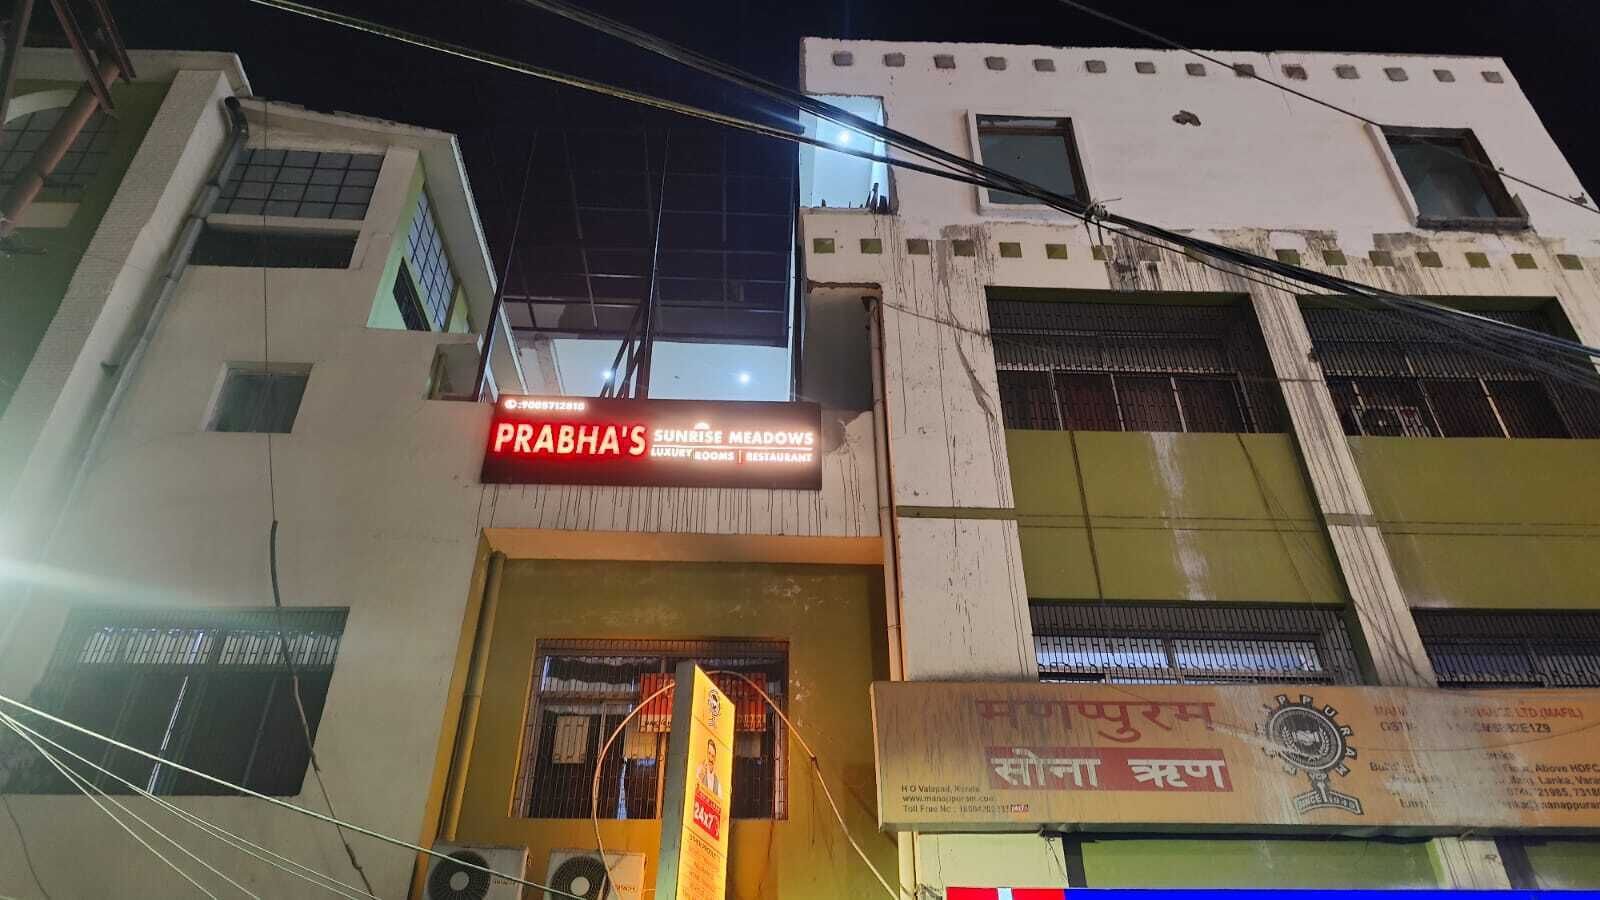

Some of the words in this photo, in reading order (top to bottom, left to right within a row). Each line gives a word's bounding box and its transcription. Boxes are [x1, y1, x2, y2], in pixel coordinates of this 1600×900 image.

[494, 423, 647, 456] PRABHA'S
[654, 430, 723, 443] SUNRISE
[729, 431, 814, 445] MEADOWS
[651, 447, 692, 457] LUXURY
[694, 450, 735, 461] ROOMS
[746, 452, 813, 462] RESTAURANT
[990, 748, 1102, 788] सोना
[1127, 758, 1226, 788] ऋण
[1535, 763, 1568, 772] Above
